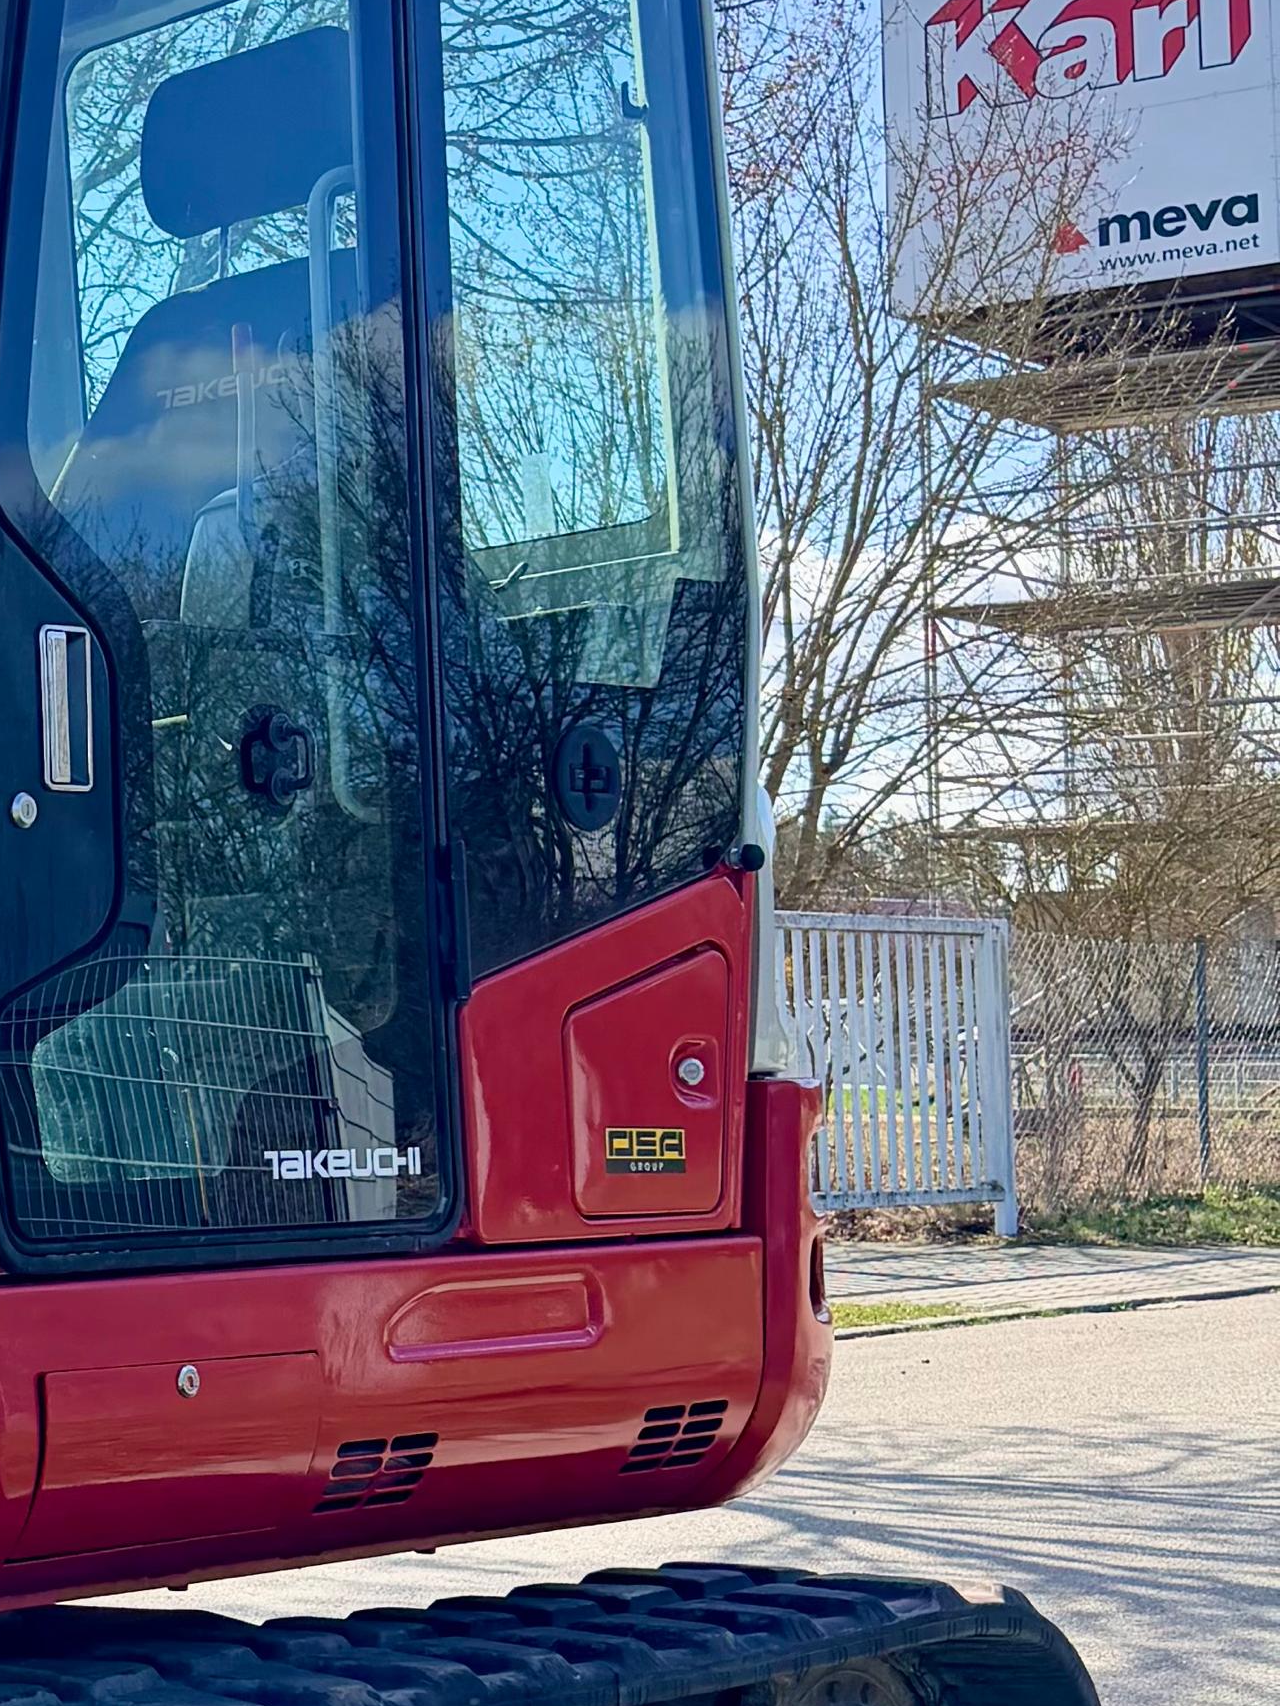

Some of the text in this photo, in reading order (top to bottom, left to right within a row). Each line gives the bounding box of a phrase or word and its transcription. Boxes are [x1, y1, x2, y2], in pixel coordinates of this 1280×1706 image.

[1098, 193, 1259, 247] meva
[1098, 233, 1260, 272] www.meva.net
[630, 1161, 664, 1172] GROUP
